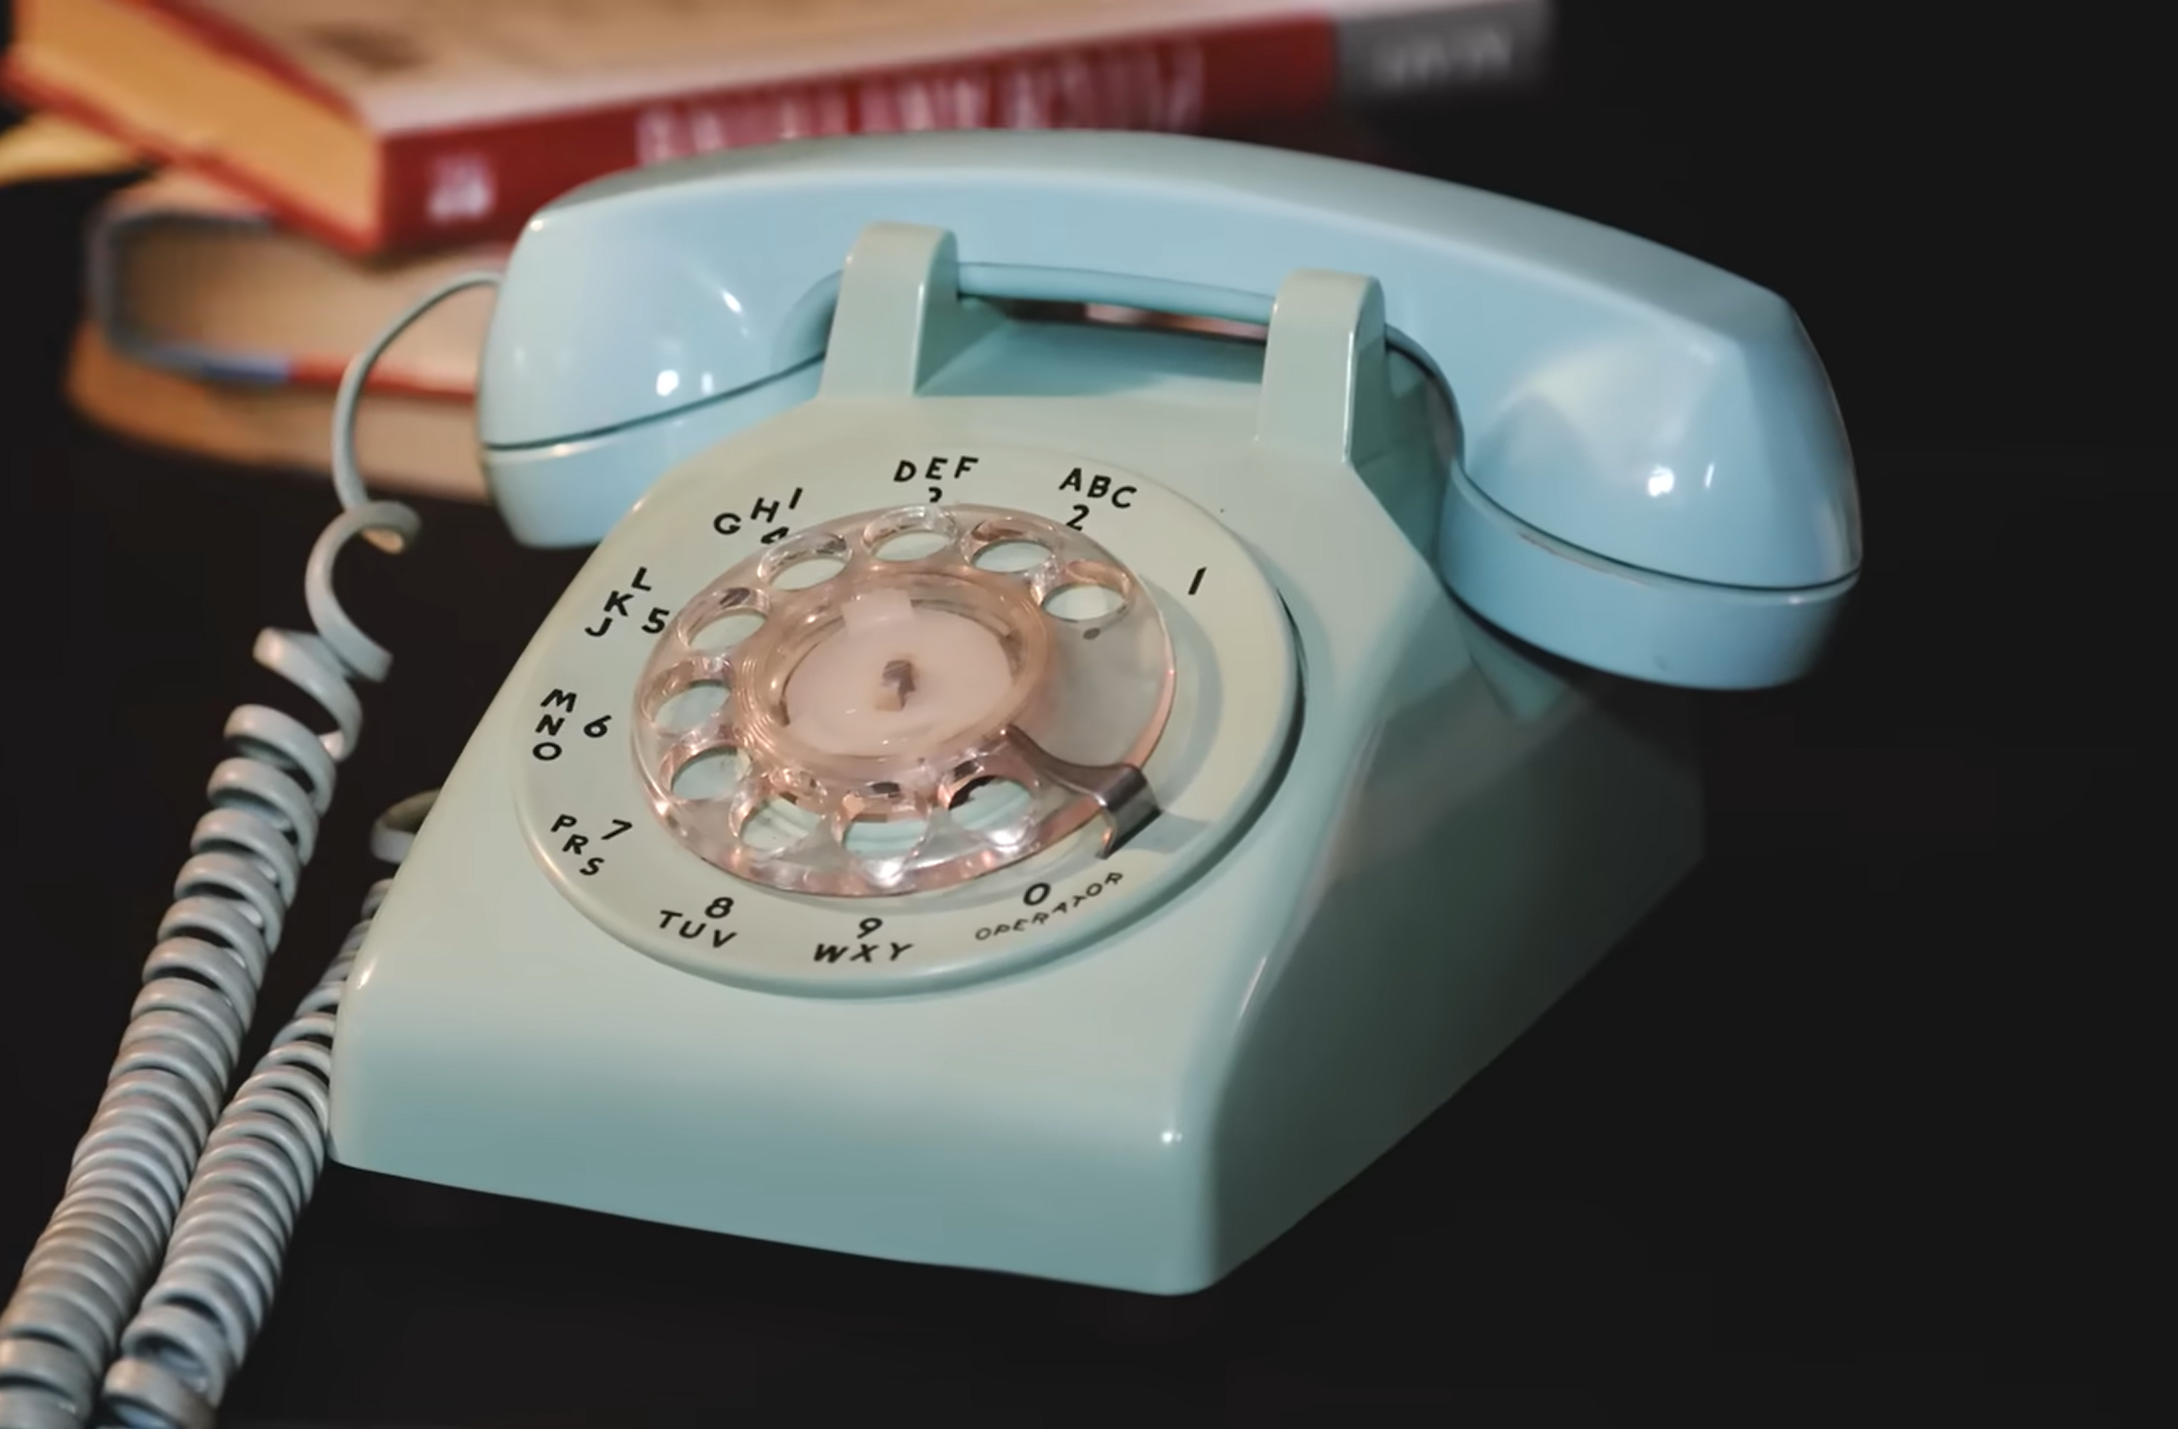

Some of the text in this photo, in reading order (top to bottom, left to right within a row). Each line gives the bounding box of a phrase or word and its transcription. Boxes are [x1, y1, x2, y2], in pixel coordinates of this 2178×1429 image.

[893, 455, 979, 483] DEF
[1057, 466, 1138, 511] ABC
[713, 487, 803, 536] GHI
[1065, 502, 1091, 531] 2
[641, 606, 671, 635] 5
[532, 688, 578, 761] MNO
[583, 714, 612, 739] 6
[600, 818, 633, 841] 7
[549, 813, 605, 876] PRS
[704, 896, 735, 920] 8
[974, 872, 1123, 941] OPERATOR
[659, 909, 738, 949] TUV
[856, 917, 883, 940] 9
[813, 942, 914, 964] WXY
